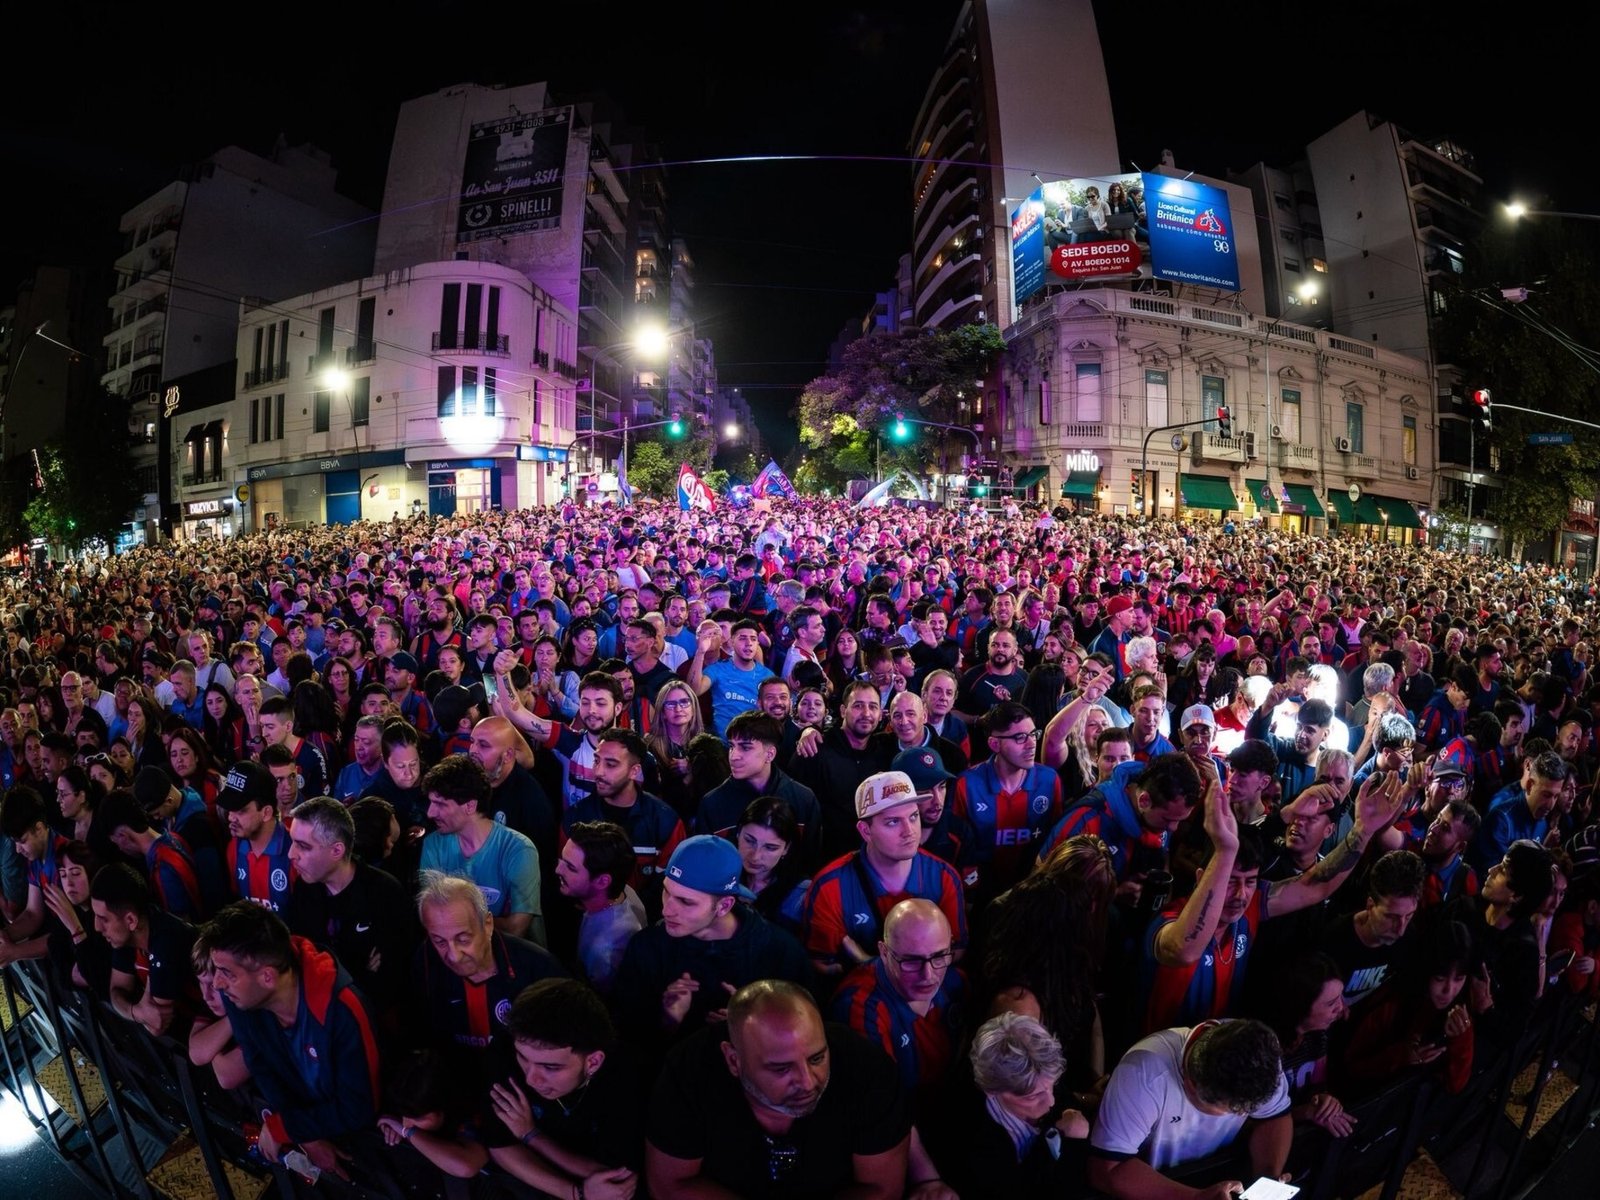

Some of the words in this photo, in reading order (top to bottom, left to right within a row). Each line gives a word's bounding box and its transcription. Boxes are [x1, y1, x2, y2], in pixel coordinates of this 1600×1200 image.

[500, 196, 552, 218] SPINELLI
[1158, 201, 1173, 211] Liceo
[1157, 209, 1194, 225] Británico
[1061, 246, 1089, 258] SEDE
[1090, 243, 1130, 256] BOEDO
[1070, 260, 1085, 268] AV.
[1085, 258, 1111, 267] BOEDO
[1112, 256, 1130, 264] 1014
[320, 459, 340, 470] BBVA
[431, 461, 449, 469] BBVA
[1066, 449, 1099, 472] MIÑO
[251, 469, 267, 479] BBVA
[1345, 963, 1389, 992] NIKE
